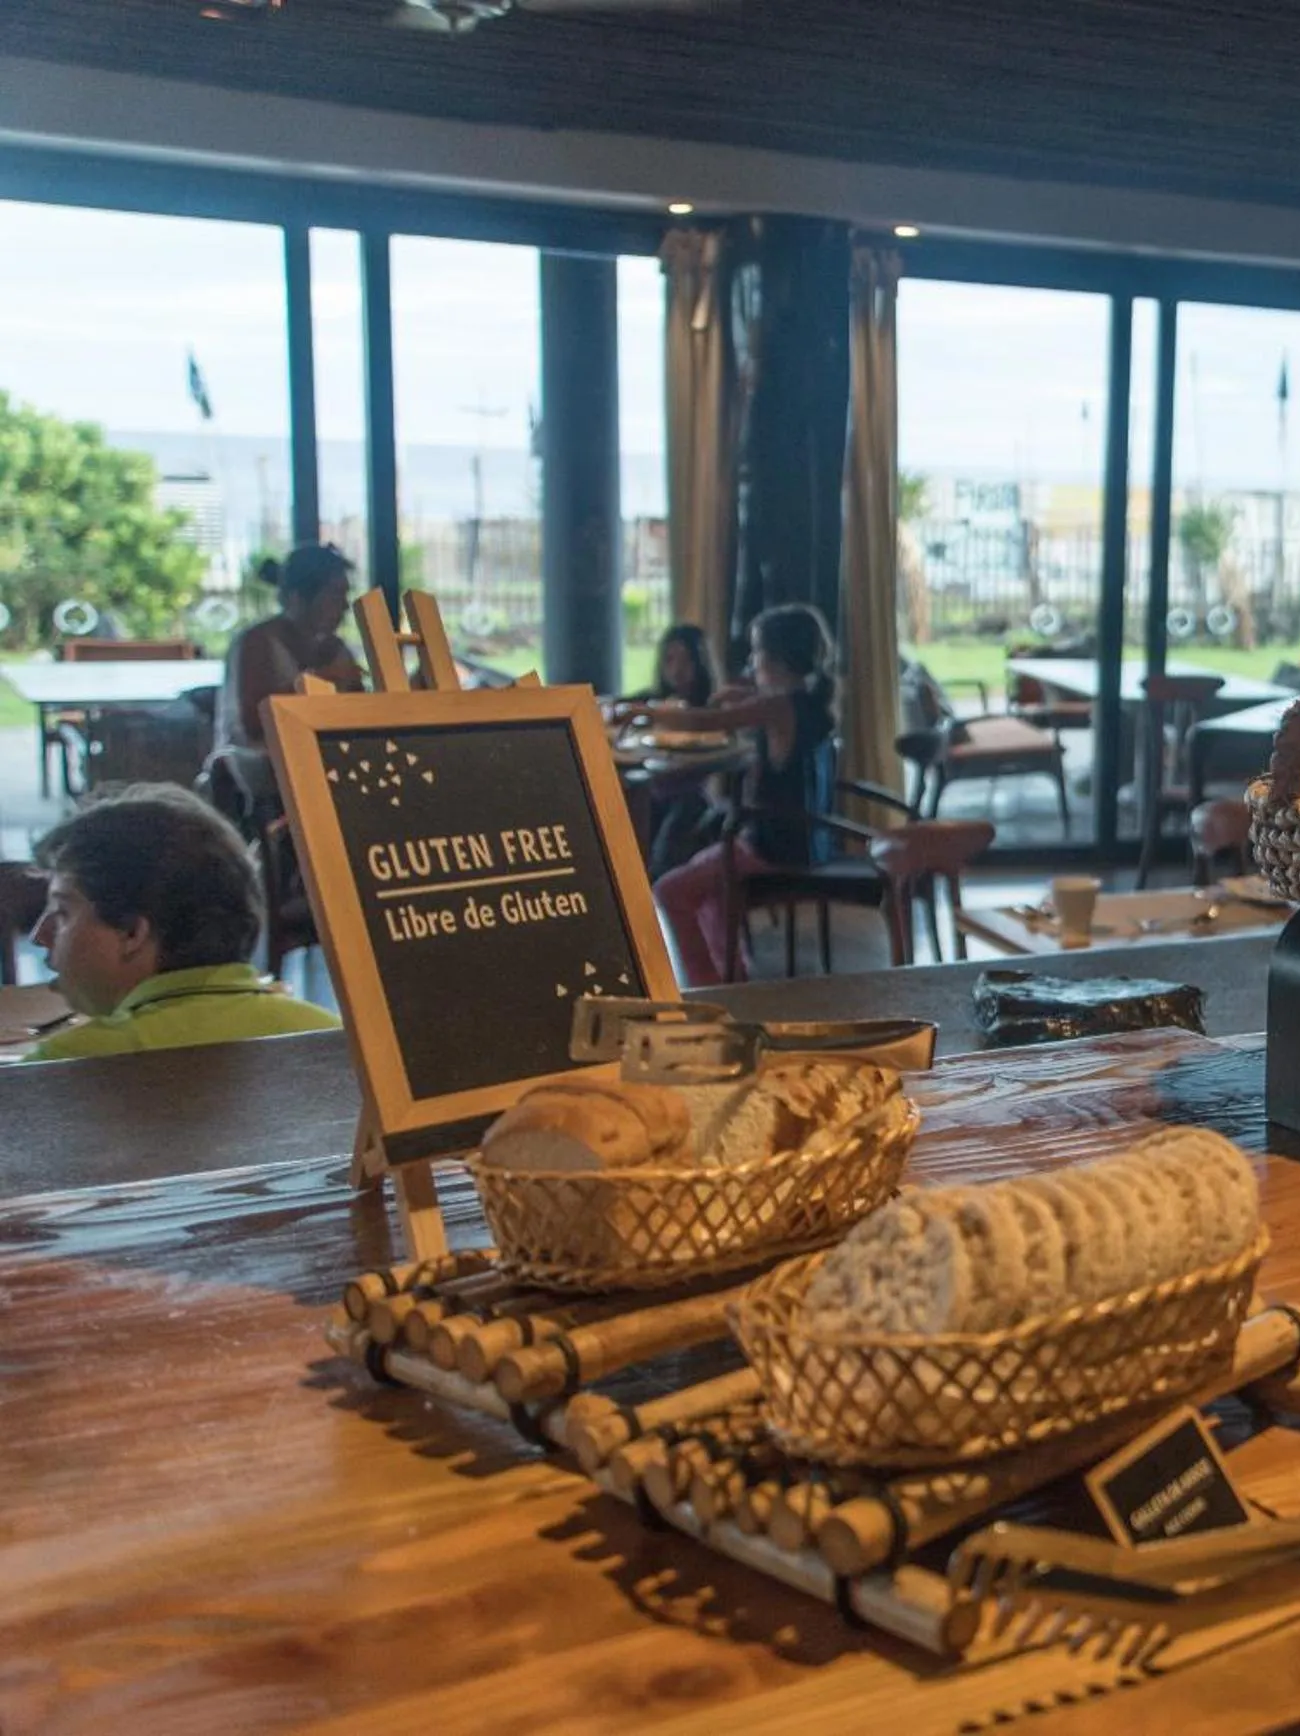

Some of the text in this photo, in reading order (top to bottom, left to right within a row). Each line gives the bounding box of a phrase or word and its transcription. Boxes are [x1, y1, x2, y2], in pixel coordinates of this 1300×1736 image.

[367, 824, 574, 882] GLUTEN FREE
[385, 888, 589, 942] Libre de Gluten
